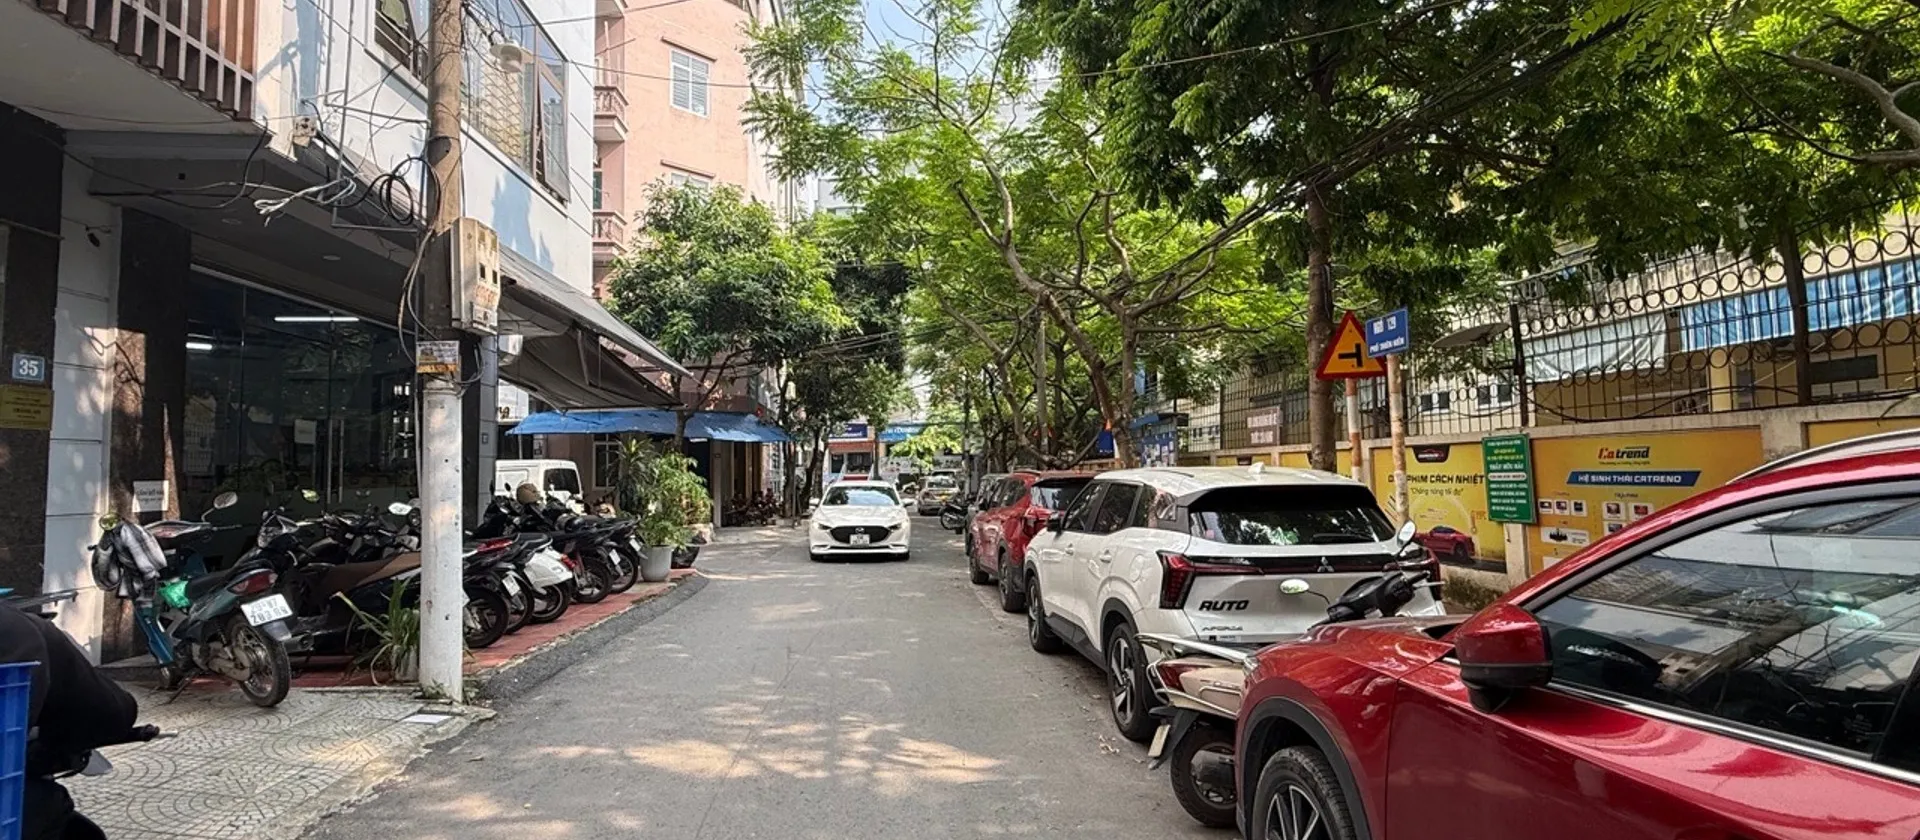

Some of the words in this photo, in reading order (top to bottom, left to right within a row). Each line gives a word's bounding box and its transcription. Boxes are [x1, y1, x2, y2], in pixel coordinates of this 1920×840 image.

[19, 359, 39, 376] 35
[1406, 474, 1428, 484] PHIM
[1429, 472, 1454, 484] CÁCH
[1578, 473, 1590, 484] HỆ
[1590, 474, 1612, 483] SINH
[1612, 473, 1633, 483] THÁI
[1634, 474, 1682, 483] CATREND
[1198, 599, 1250, 611] AUTO
